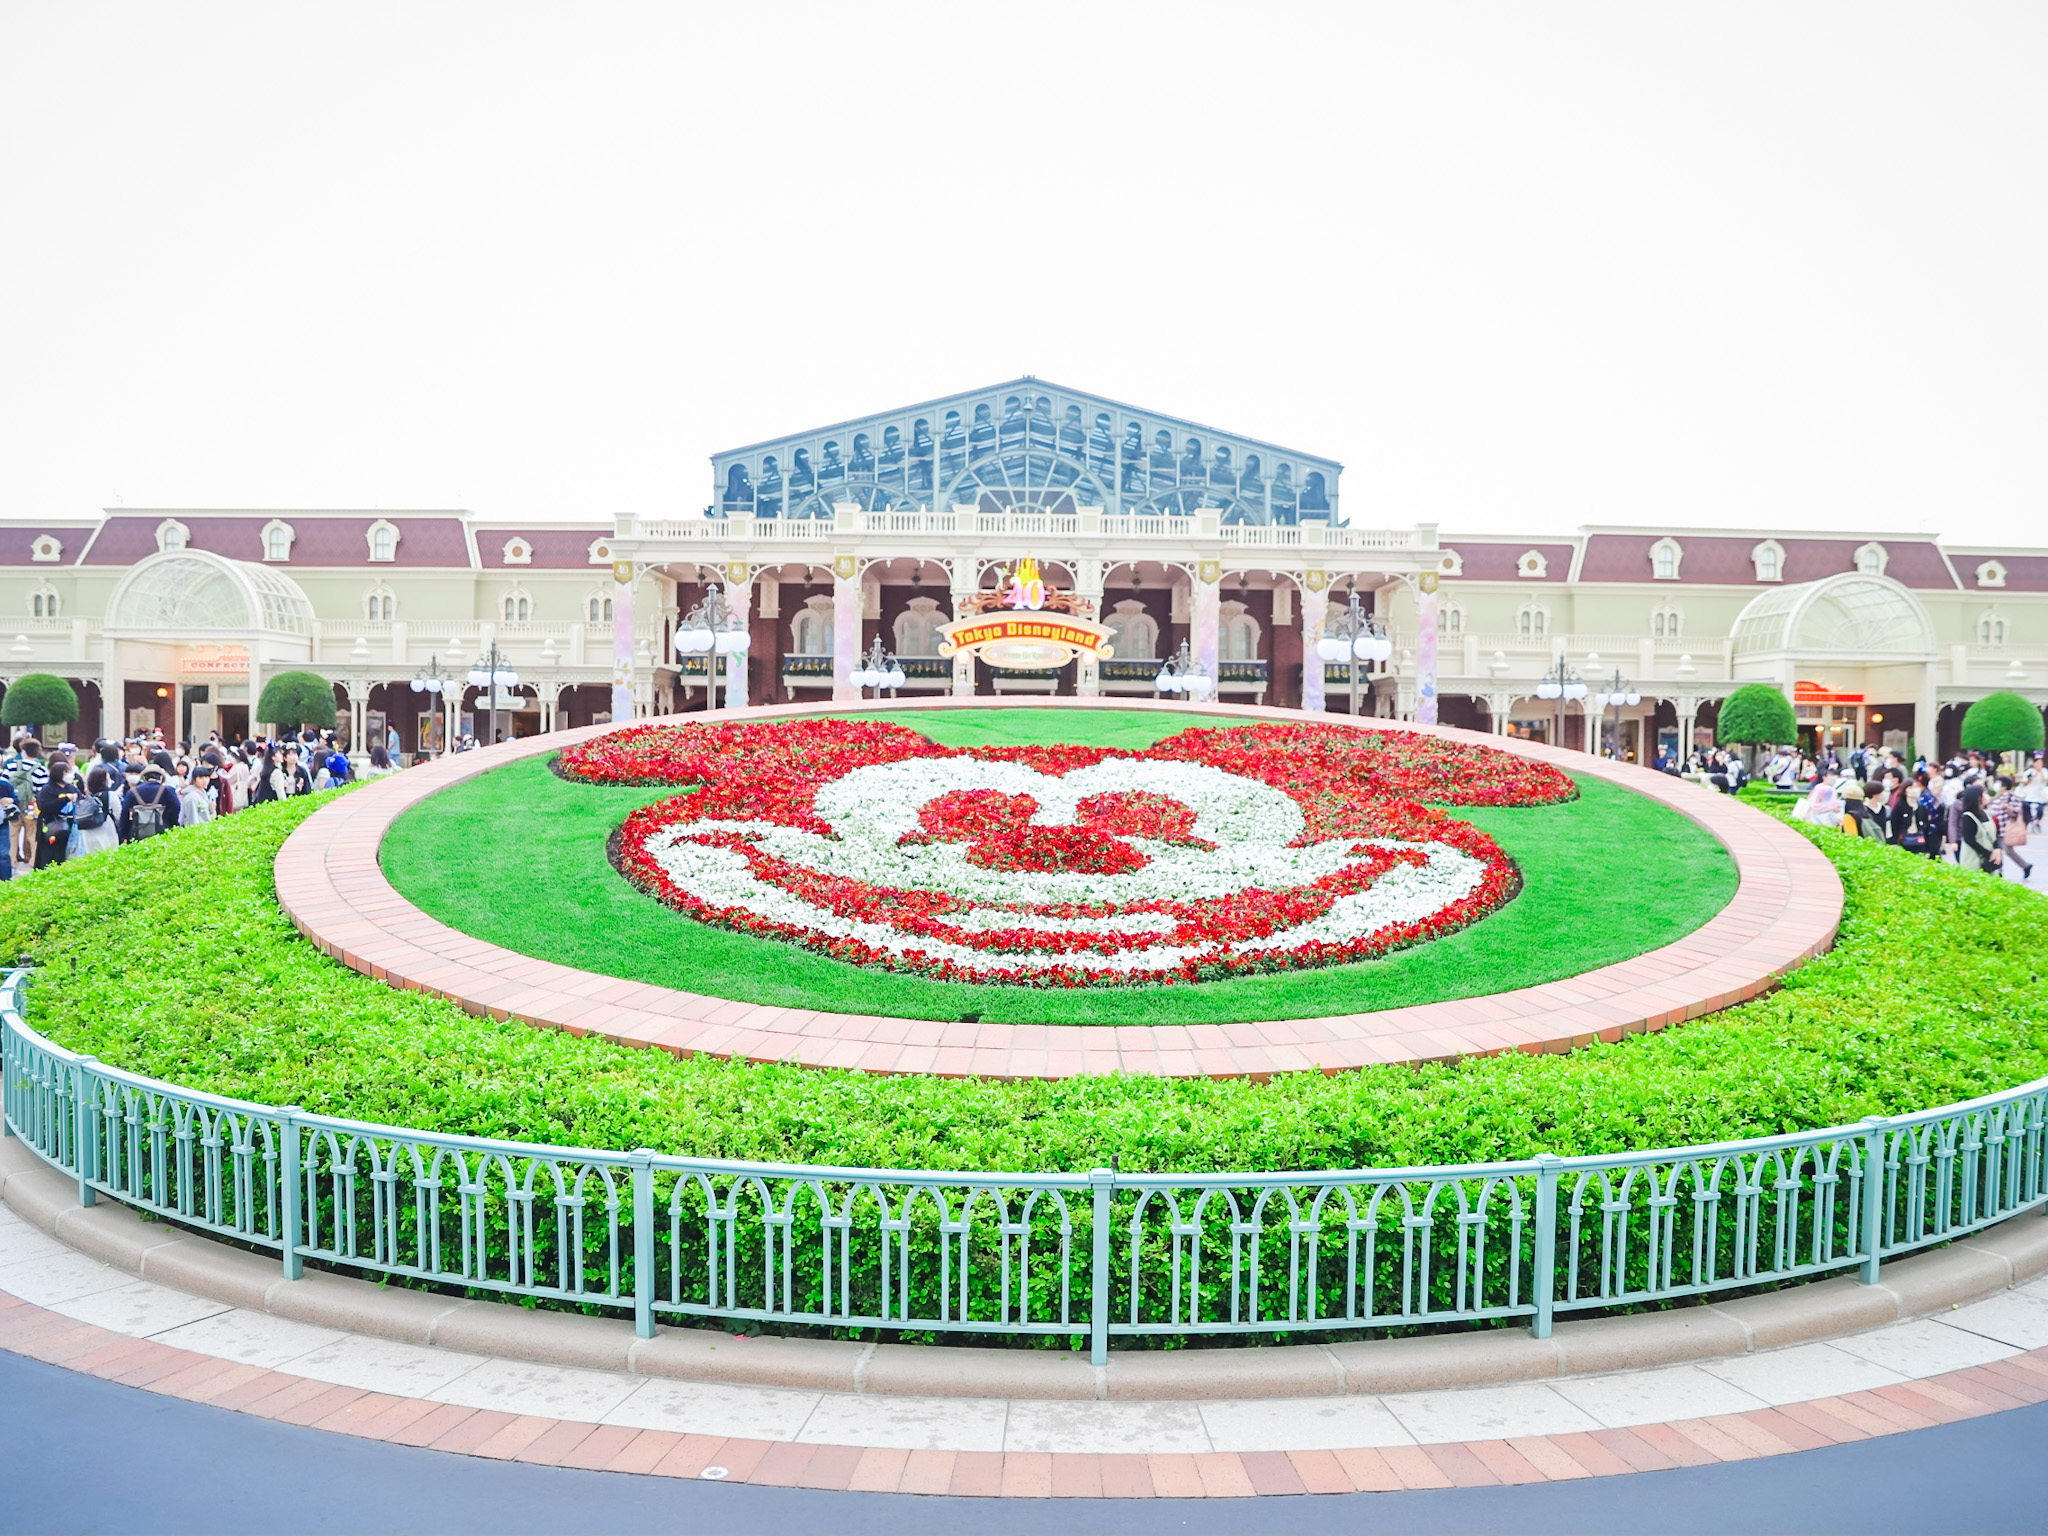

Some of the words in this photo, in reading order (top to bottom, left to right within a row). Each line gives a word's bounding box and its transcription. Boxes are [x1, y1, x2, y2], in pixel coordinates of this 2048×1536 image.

[1003, 576, 1046, 610] 40
[955, 626, 1003, 645] Tokyo
[1006, 622, 1096, 647] Disneyland
